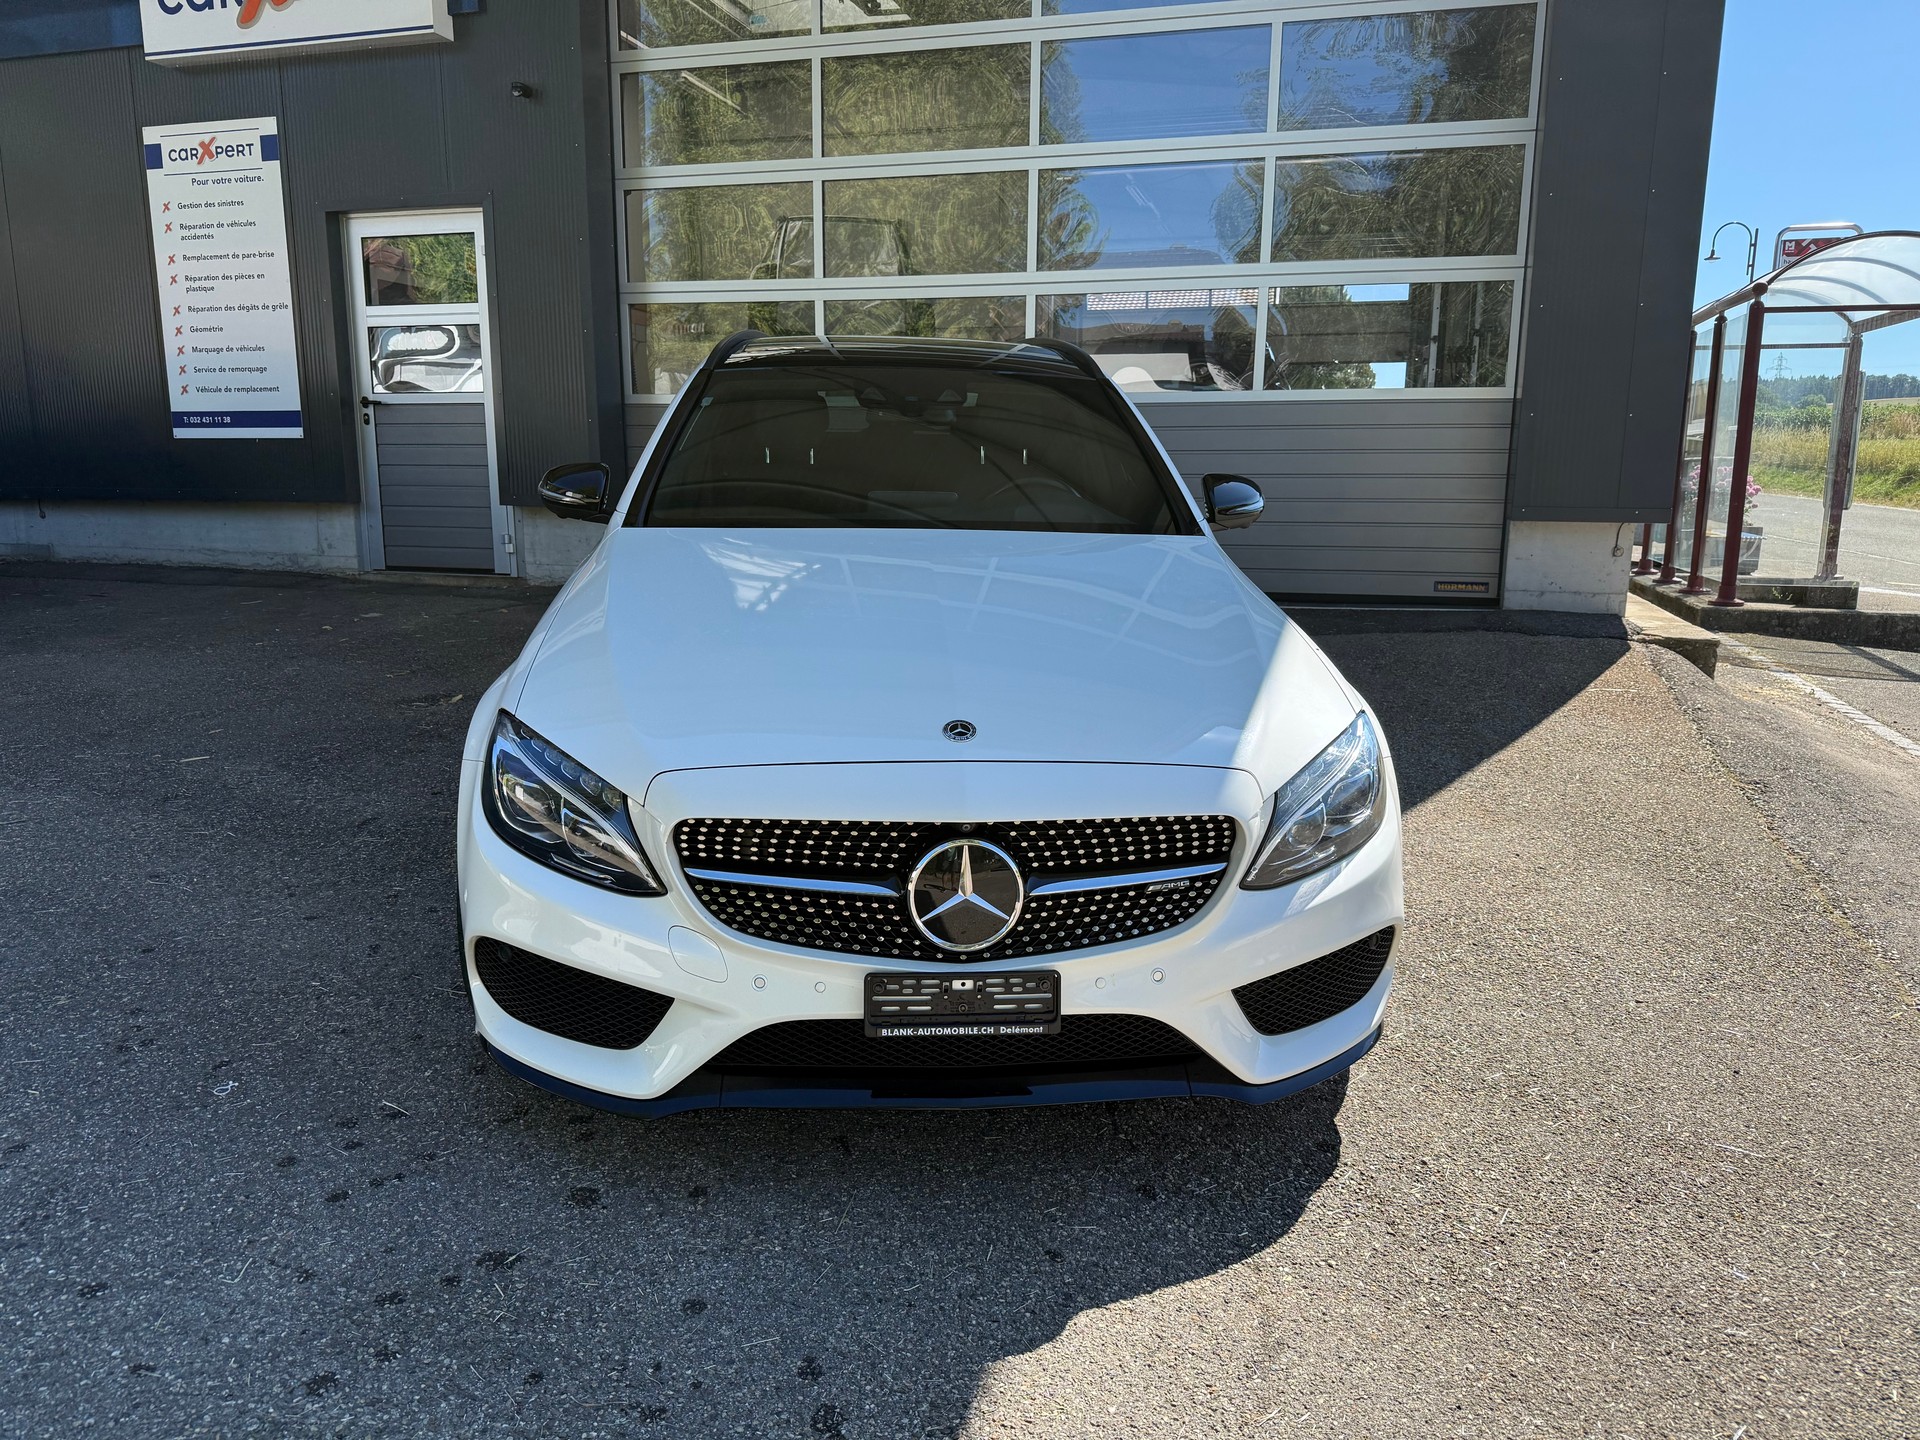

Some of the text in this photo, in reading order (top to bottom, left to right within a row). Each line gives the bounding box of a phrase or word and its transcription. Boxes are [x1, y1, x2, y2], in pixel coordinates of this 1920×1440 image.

[191, 175, 264, 186] Pour votre voiture.
[177, 202, 202, 210] Gestion
[180, 222, 214, 231] Réparation
[226, 220, 256, 228] véhicules
[180, 232, 214, 241] accidentés
[182, 254, 230, 262] Remplacement
[242, 251, 275, 260] pare-brise
[184, 274, 220, 283] Réparation
[234, 273, 255, 282] pièces
[186, 285, 215, 294] plastique
[188, 305, 222, 314] Réparation
[237, 304, 260, 313] dégâts
[272, 303, 288, 312] grêle
[192, 346, 224, 354] Marquage
[234, 385, 280, 394] remplacement
[882, 1025, 1043, 1036] BLANK-AUTOMOBILE.CH Delémont
